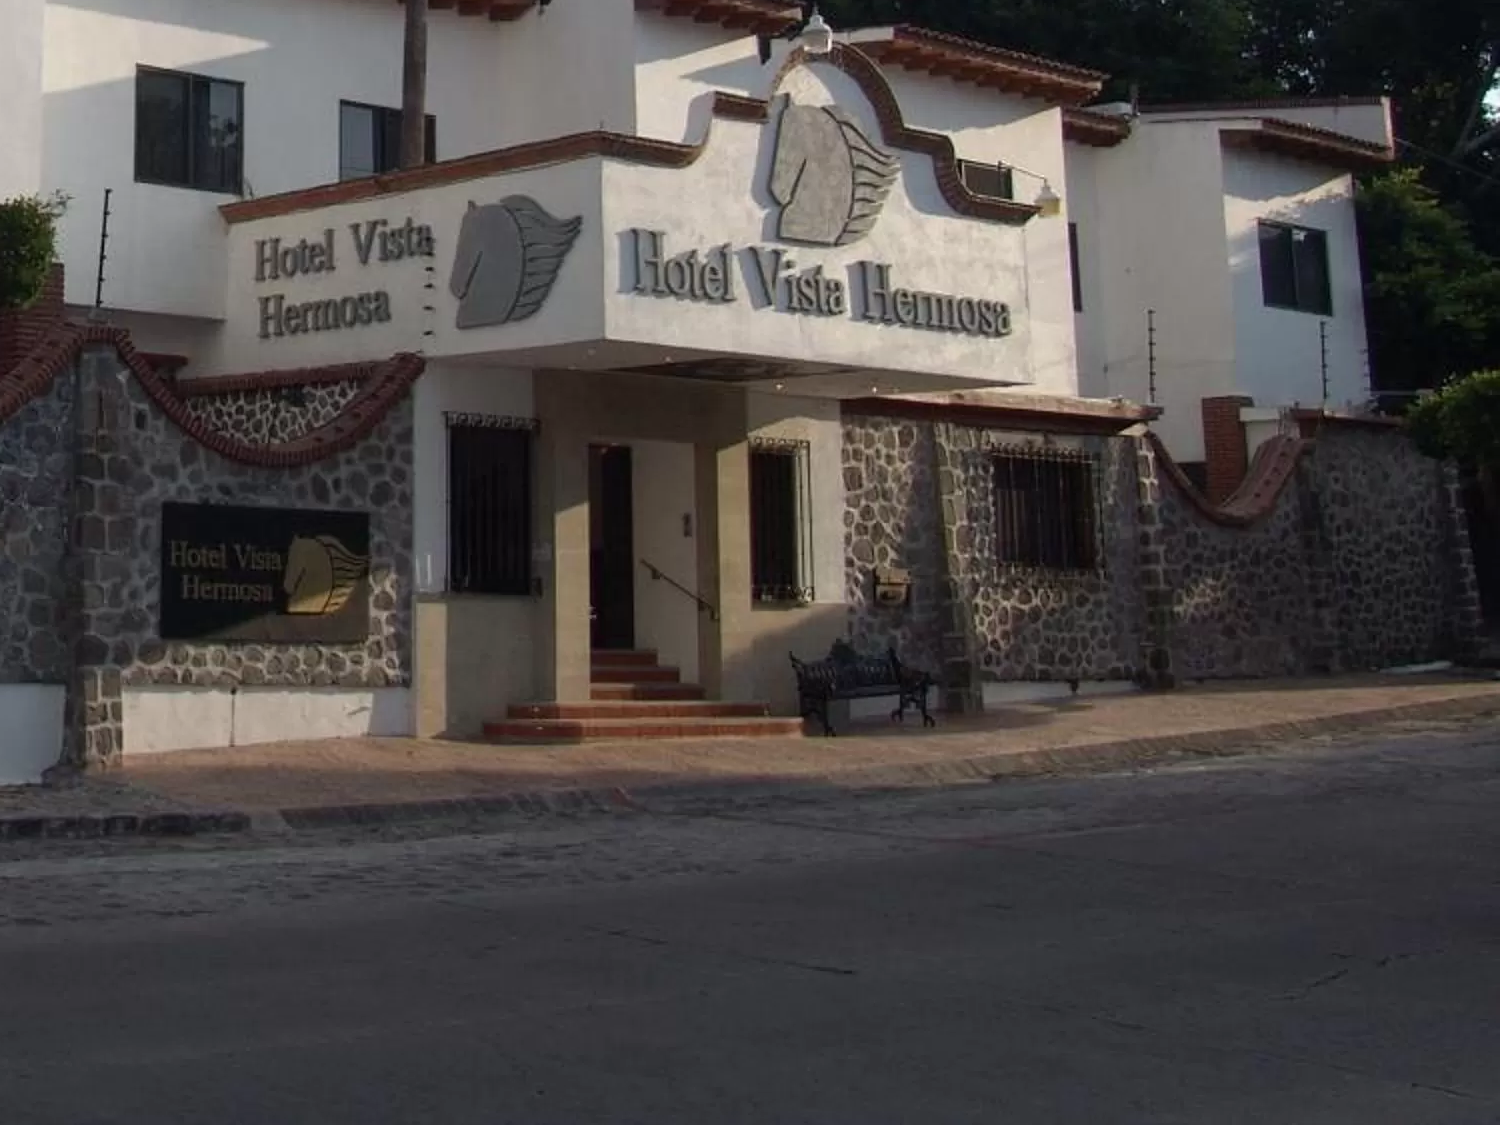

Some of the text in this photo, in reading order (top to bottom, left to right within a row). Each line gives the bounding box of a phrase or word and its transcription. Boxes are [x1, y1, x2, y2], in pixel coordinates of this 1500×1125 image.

[254, 216, 434, 281] Hotel Vista
[627, 227, 1013, 338] Hotel Vista Hermosa
[257, 289, 392, 339] Hermosa
[170, 539, 282, 571] Hotel Vista
[181, 574, 274, 603] Hermosa
